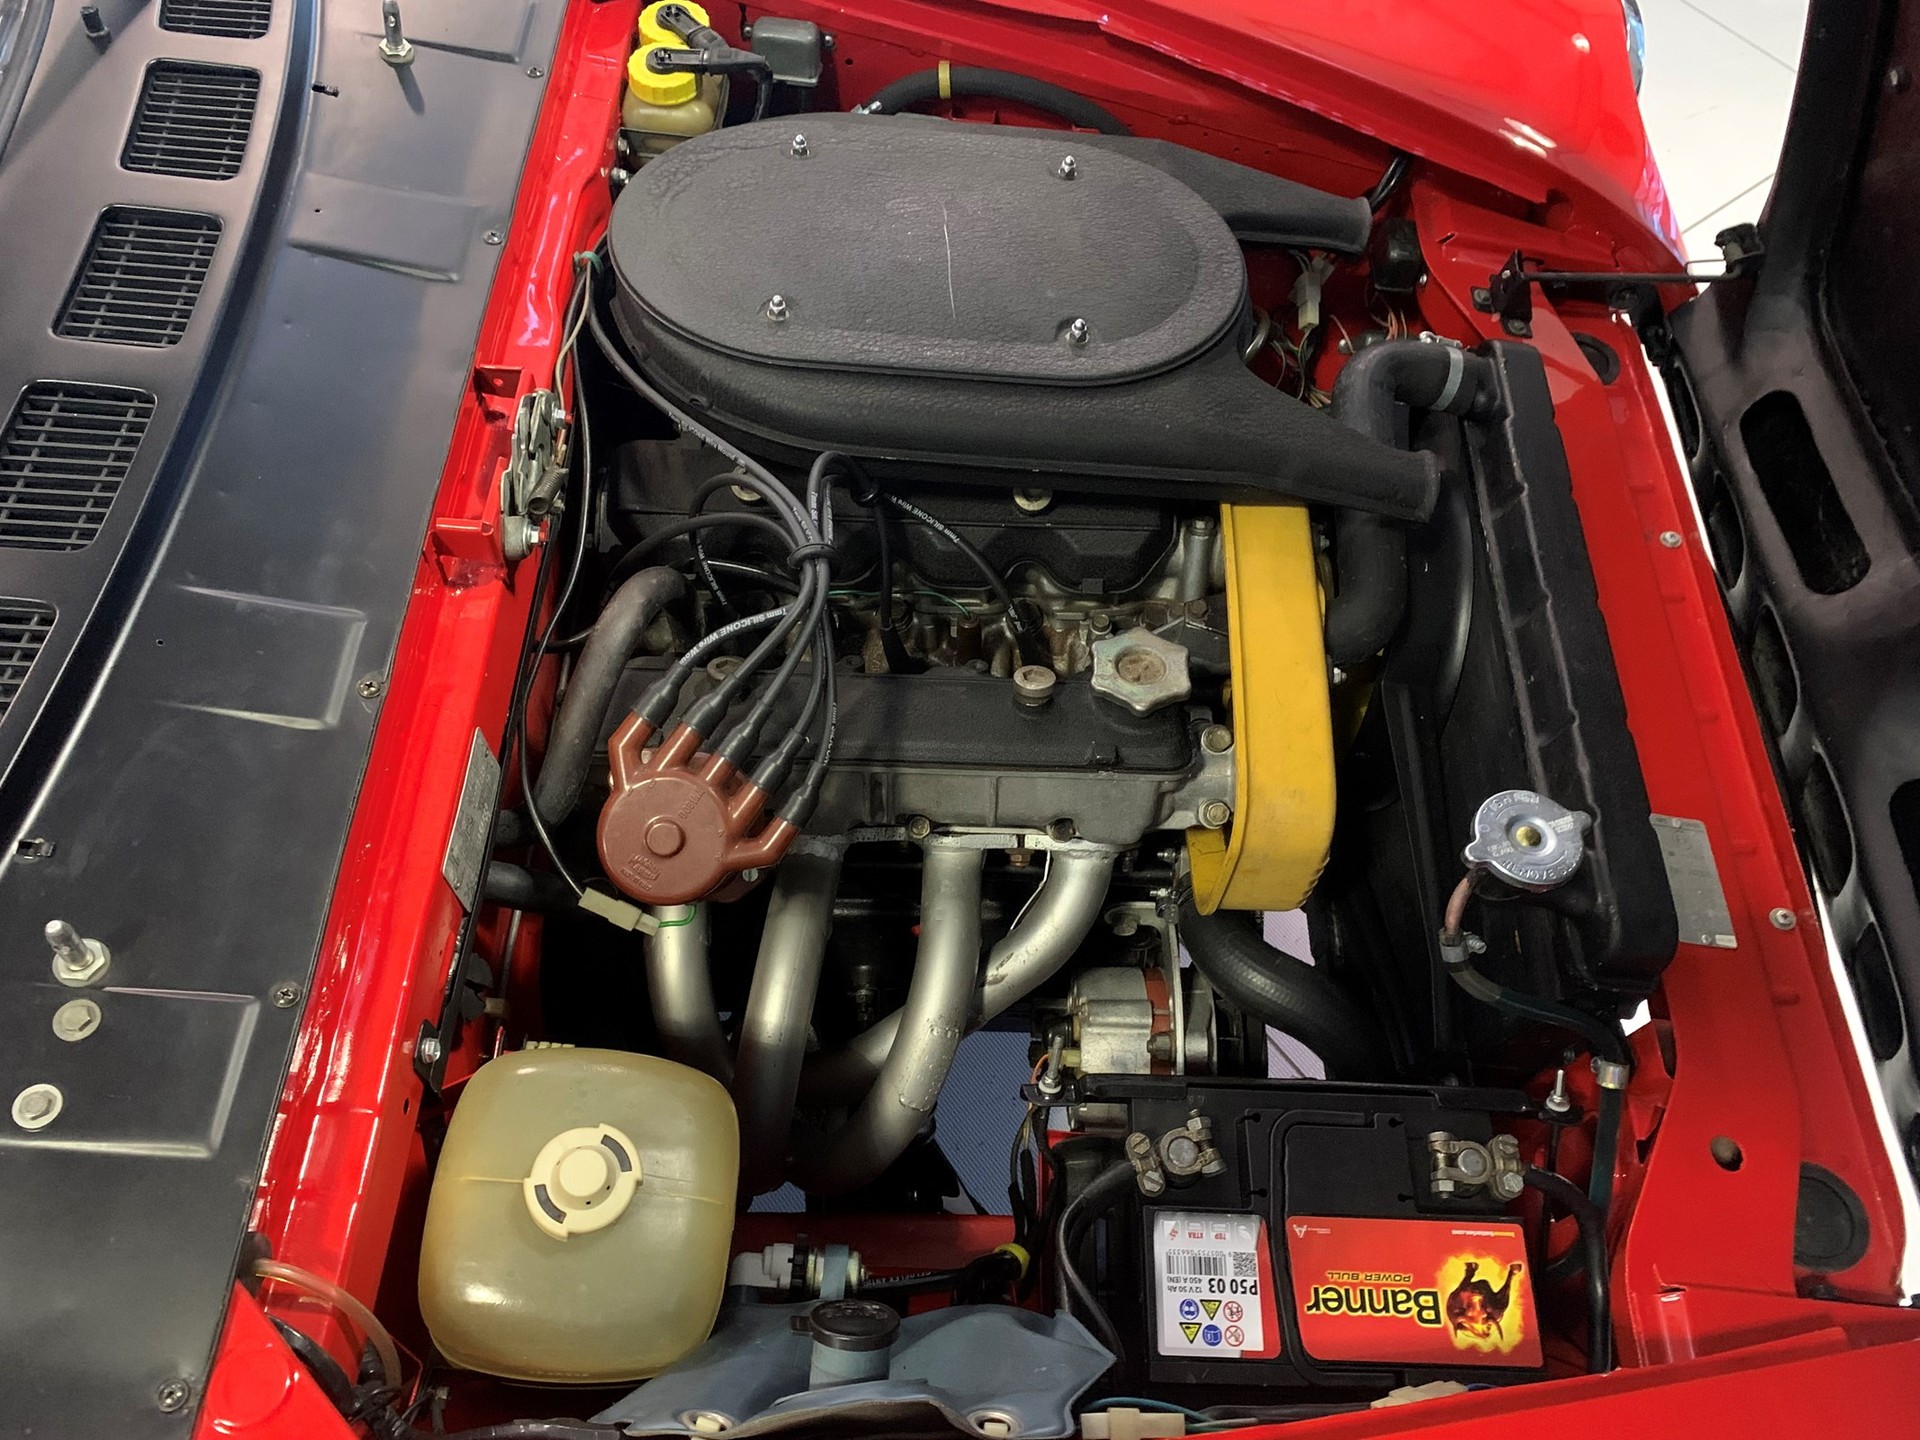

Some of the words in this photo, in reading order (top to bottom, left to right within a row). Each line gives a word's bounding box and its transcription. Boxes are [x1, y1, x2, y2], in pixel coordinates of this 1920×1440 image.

[897, 499, 913, 512] Wire
[911, 507, 945, 531] SILICONE
[943, 528, 961, 544] 7mm
[767, 607, 788, 619] 7mm
[719, 613, 766, 637] SILICONE
[698, 631, 719, 648] Wire
[1166, 1275, 1182, 1284] (EN)
[1188, 1276, 1203, 1285] 450
[1326, 1271, 1361, 1281] BULL
[1364, 1273, 1411, 1283] POWER
[1167, 1285, 1178, 1294] Ah
[1208, 1277, 1226, 1294] 03
[1230, 1278, 1258, 1296] P50
[1306, 1286, 1443, 1326] Banner
